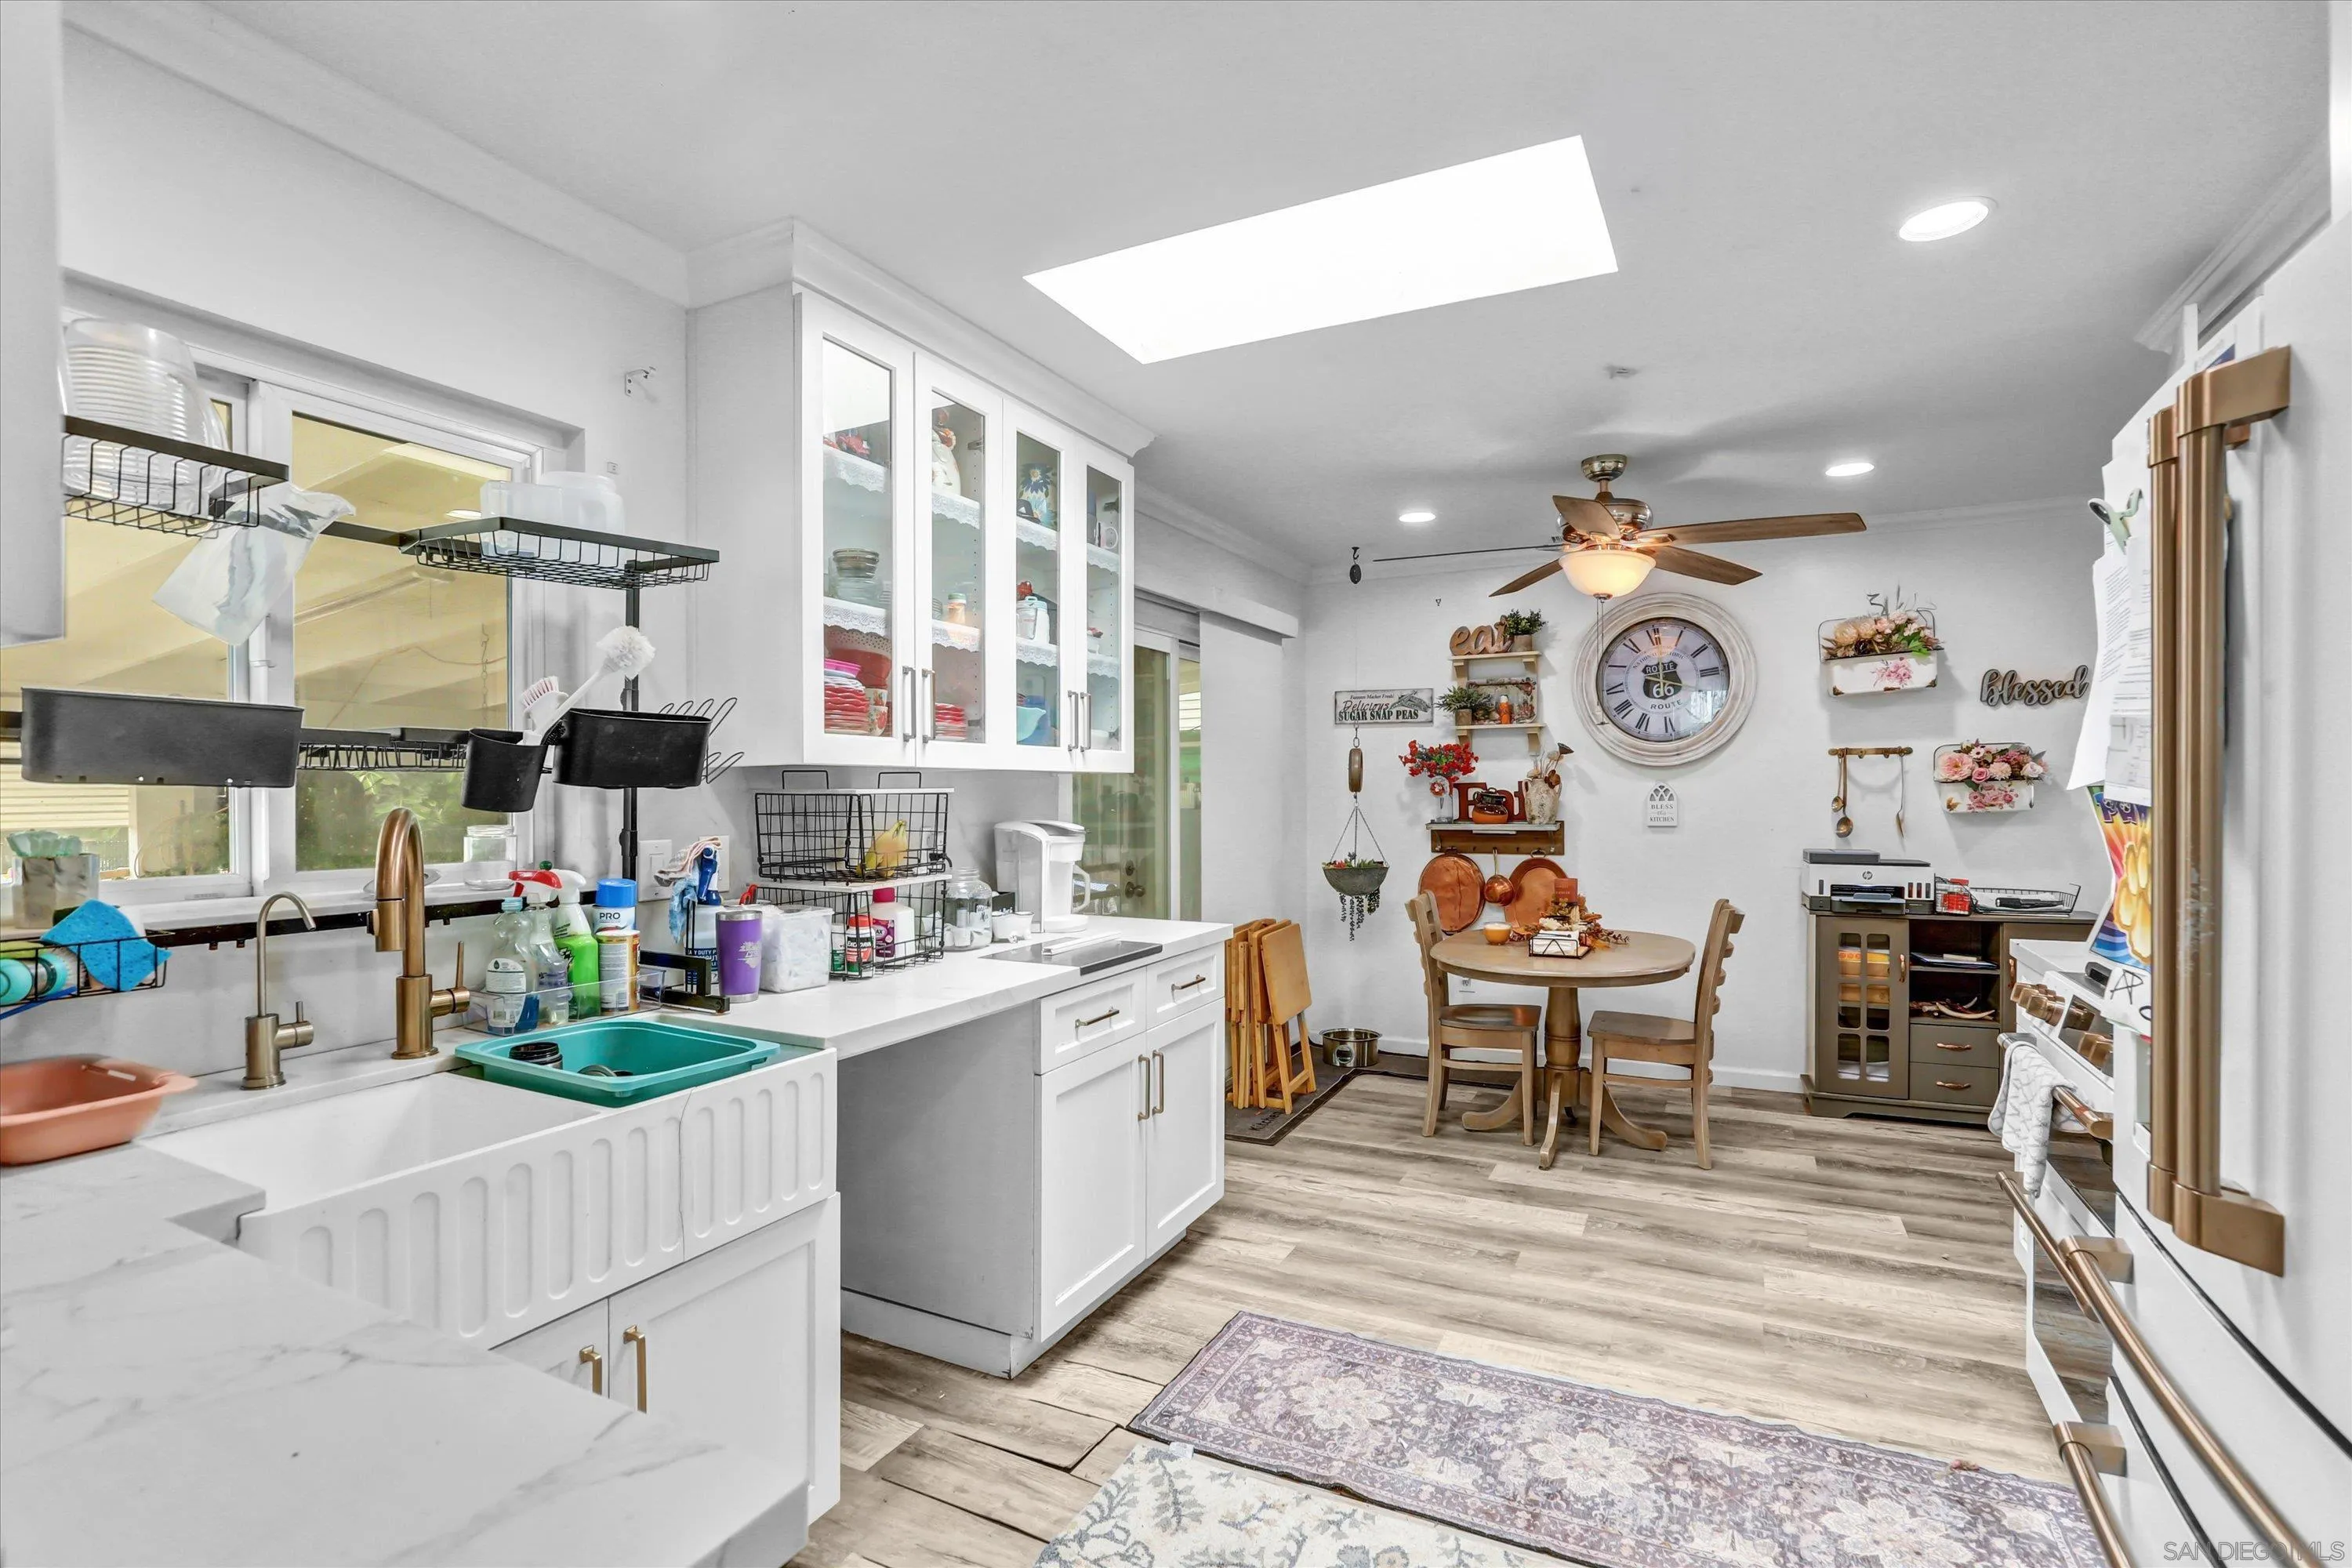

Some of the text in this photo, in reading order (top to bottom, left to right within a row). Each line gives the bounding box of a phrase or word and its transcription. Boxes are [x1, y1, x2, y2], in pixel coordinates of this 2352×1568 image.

[1449, 615, 1515, 655] eat
[1646, 662, 1675, 673] ROUTE
[1653, 683, 1675, 698] 66
[1980, 665, 2089, 706] blessed
[1342, 700, 1390, 712] Delicious
[1650, 699, 1682, 710] ROUTE
[1338, 709, 1418, 720] SUGAR SNAP PEAS
